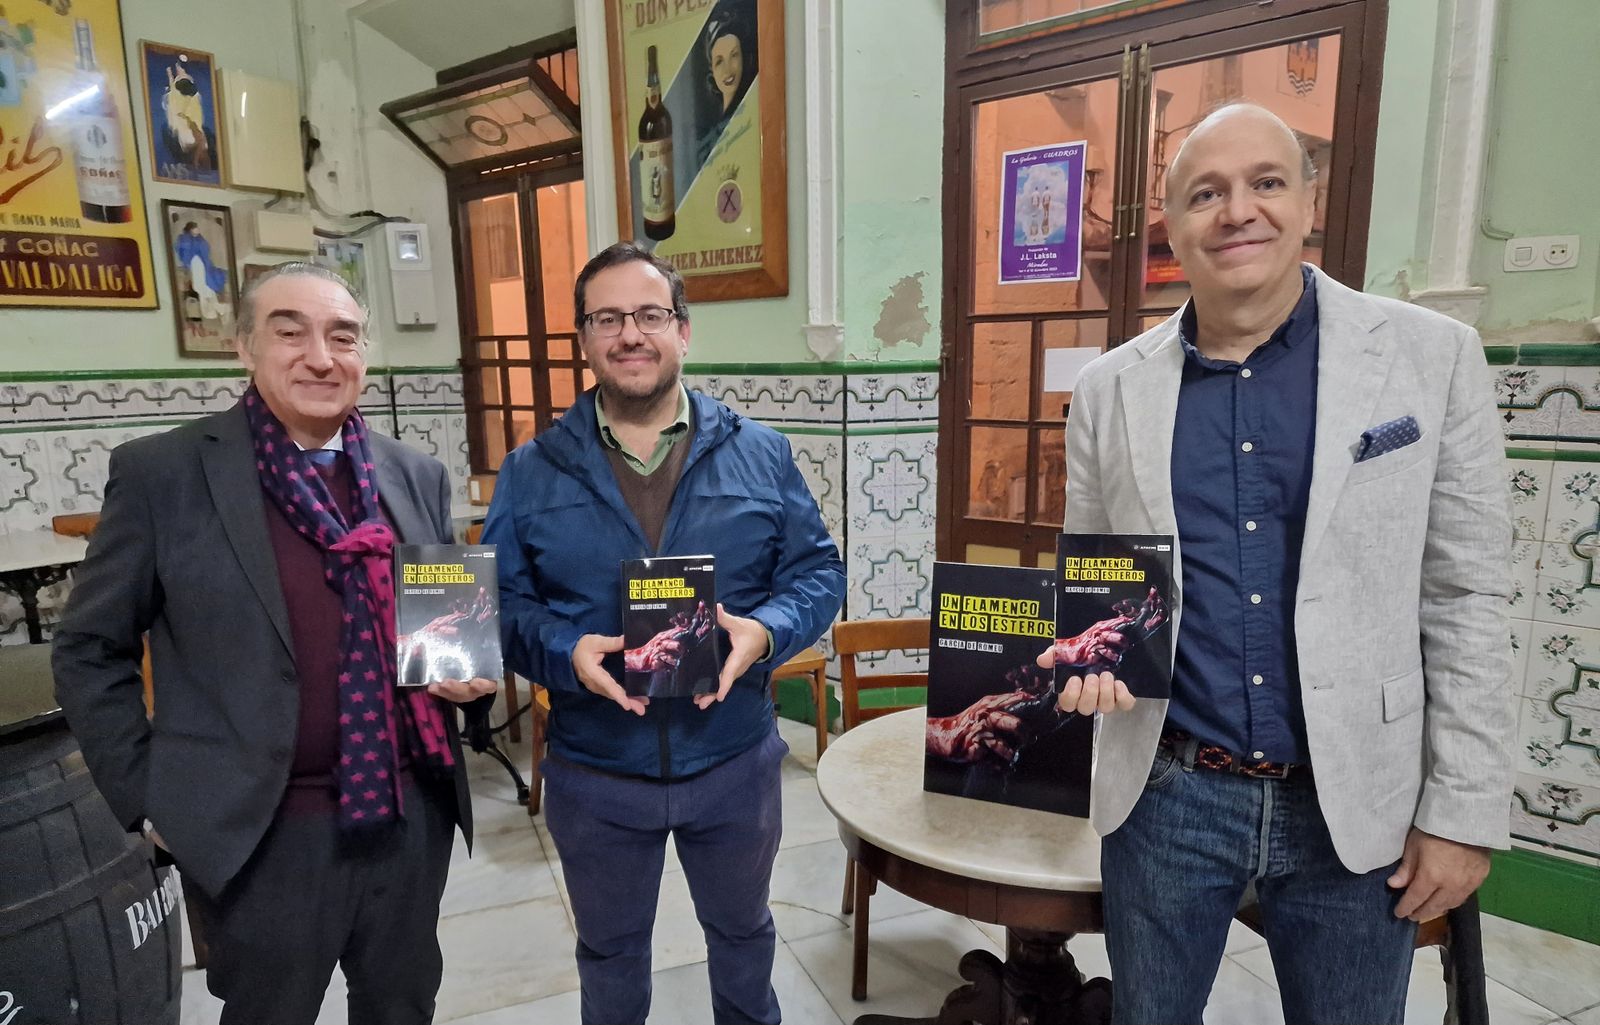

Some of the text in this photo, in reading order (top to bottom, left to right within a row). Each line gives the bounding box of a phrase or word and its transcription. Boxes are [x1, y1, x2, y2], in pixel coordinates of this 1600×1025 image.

[1043, 149, 1078, 159] CUADROS
[12, 213, 46, 226] SANTA
[17, 234, 99, 257] COÑAC
[701, 244, 762, 268] XIMENEZ
[0, 259, 139, 292] VALDALIGA
[404, 565, 463, 573] UN FLAMENCO
[1067, 558, 1132, 569] UN FLAMENCO
[404, 574, 474, 583] EN LOS ESTEROS
[1066, 570, 1144, 581] EN LOS ESTEROS
[630, 579, 684, 589] UN FLAMENCO
[630, 588, 694, 599] EN LOS ESTEROS
[942, 595, 1038, 617] UN FLAMENCO
[941, 612, 1055, 637] EN LOS ESTEROS
